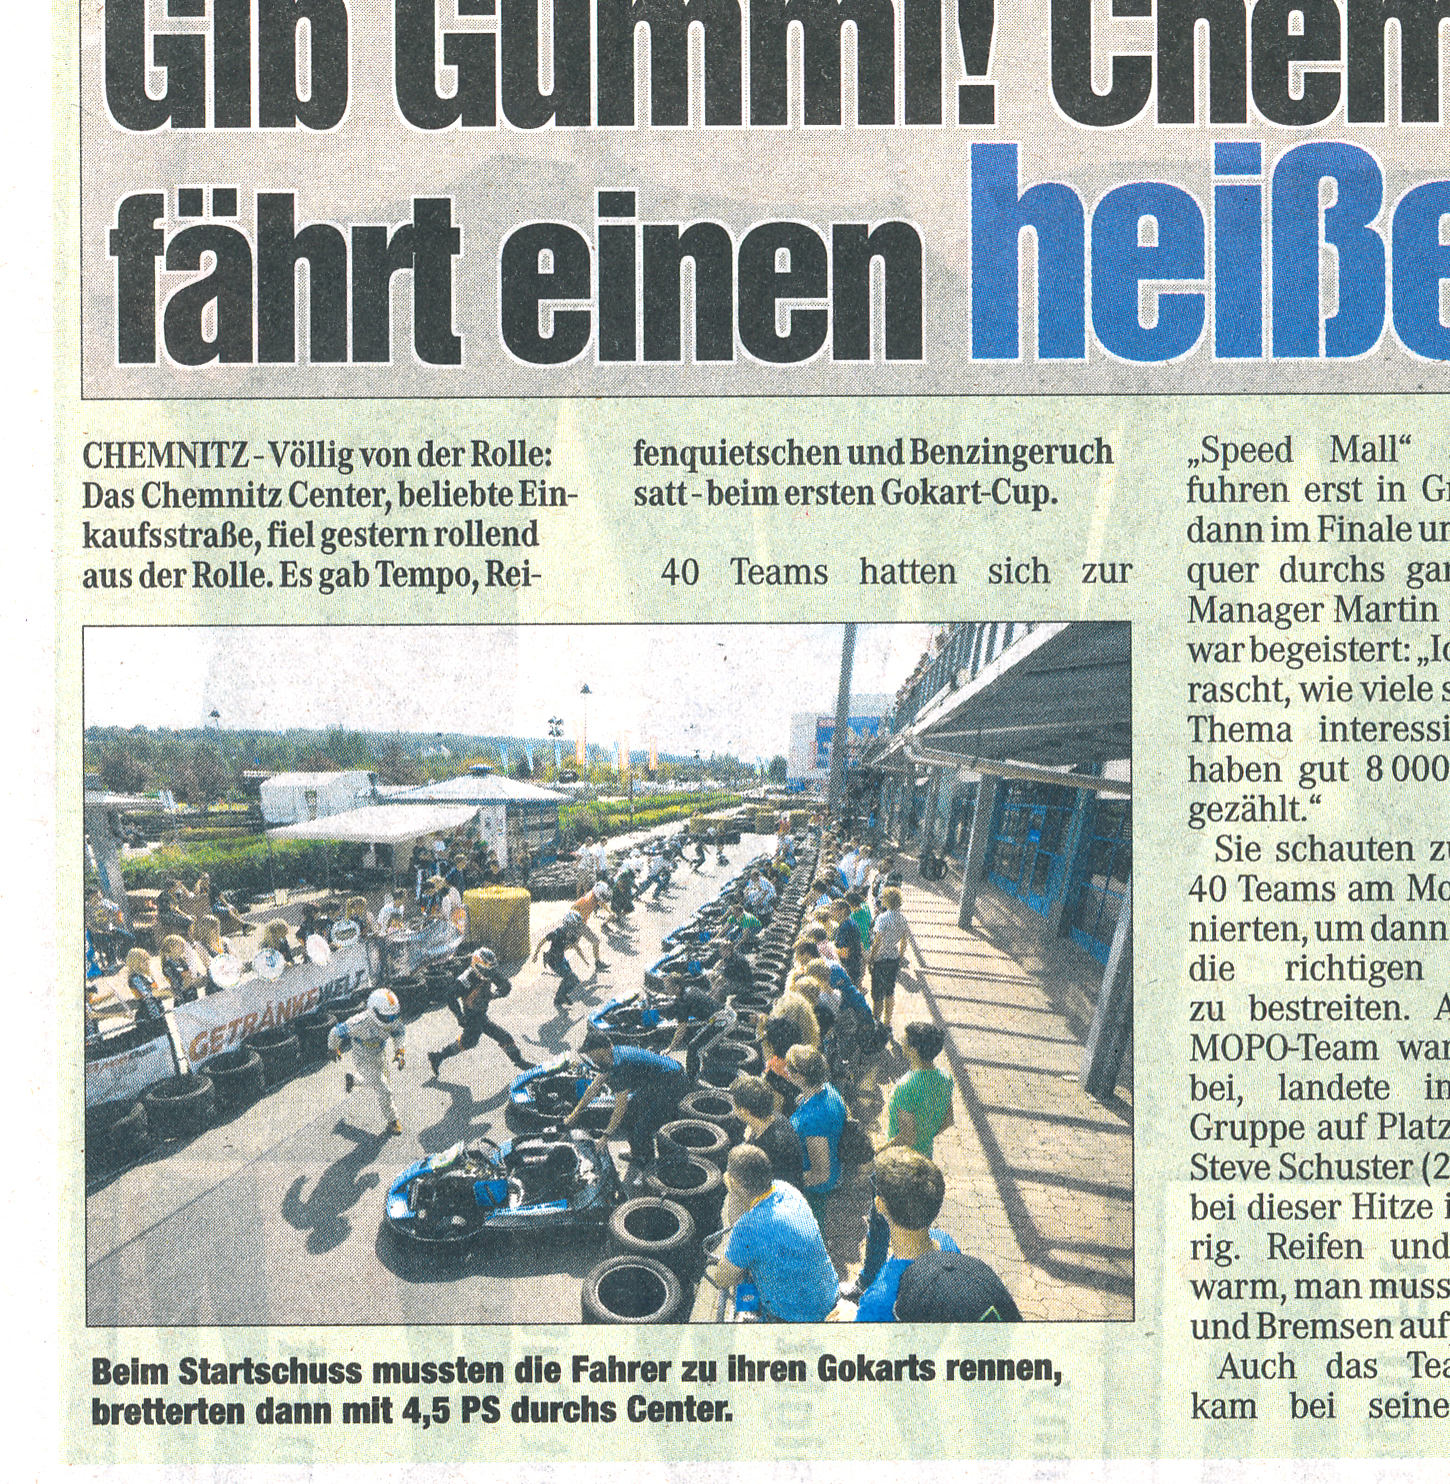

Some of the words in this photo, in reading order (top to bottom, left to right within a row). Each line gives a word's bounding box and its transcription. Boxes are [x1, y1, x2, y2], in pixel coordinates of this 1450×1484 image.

[108, 191, 462, 367] fährt
[500, 191, 923, 367] einen
[633, 438, 841, 474] fenquietschen
[847, 437, 905, 466] und
[910, 436, 1114, 472] Benzingeruch
[1188, 435, 1293, 471] „Speed
[1330, 434, 1411, 463] Mall“
[83, 481, 135, 509] Das
[141, 480, 282, 509] Chemnitz
[288, 480, 392, 516] Center,
[397, 479, 514, 508] beliebte
[518, 479, 578, 507] Ein-
[82, 520, 262, 556] kaufsstraße,
[267, 520, 315, 548] fiel
[320, 522, 429, 555] gestern
[434, 519, 540, 547] rollend
[661, 557, 700, 586] 40
[730, 557, 828, 586] Teams
[860, 556, 957, 585] hatten
[988, 556, 1051, 585] sich
[1082, 562, 1134, 584] zur
[1188, 595, 1325, 630] Manager
[1335, 594, 1439, 623] Martin
[1187, 714, 1292, 743] Thema
[1187, 794, 1321, 830] gezählt.“
[1189, 954, 1235, 982] die
[1286, 953, 1424, 988] richtigen
[1190, 1033, 1379, 1062] MOPO-Team
[1191, 1311, 1251, 1340] und
[1256, 1311, 1392, 1340] Bremsen
[92, 1357, 169, 1386] Beim
[178, 1356, 363, 1385] Startschuss
[373, 1356, 504, 1384] mussten
[514, 1355, 562, 1384] die
[572, 1355, 672, 1383] Fahrer
[681, 1360, 717, 1383] zu
[728, 1354, 807, 1382] ihren
[817, 1353, 936, 1382] Gokarts
[946, 1359, 1062, 1387] rennen,
[1217, 1351, 1297, 1380] Auch
[1326, 1351, 1378, 1379] das
[92, 1397, 245, 1426] bretterten
[255, 1396, 332, 1425] dann
[342, 1396, 393, 1424] mit
[402, 1396, 451, 1430] 4,5
[461, 1395, 501, 1424] PS
[511, 1395, 617, 1424] durchs
[627, 1394, 733, 1423] Center.
